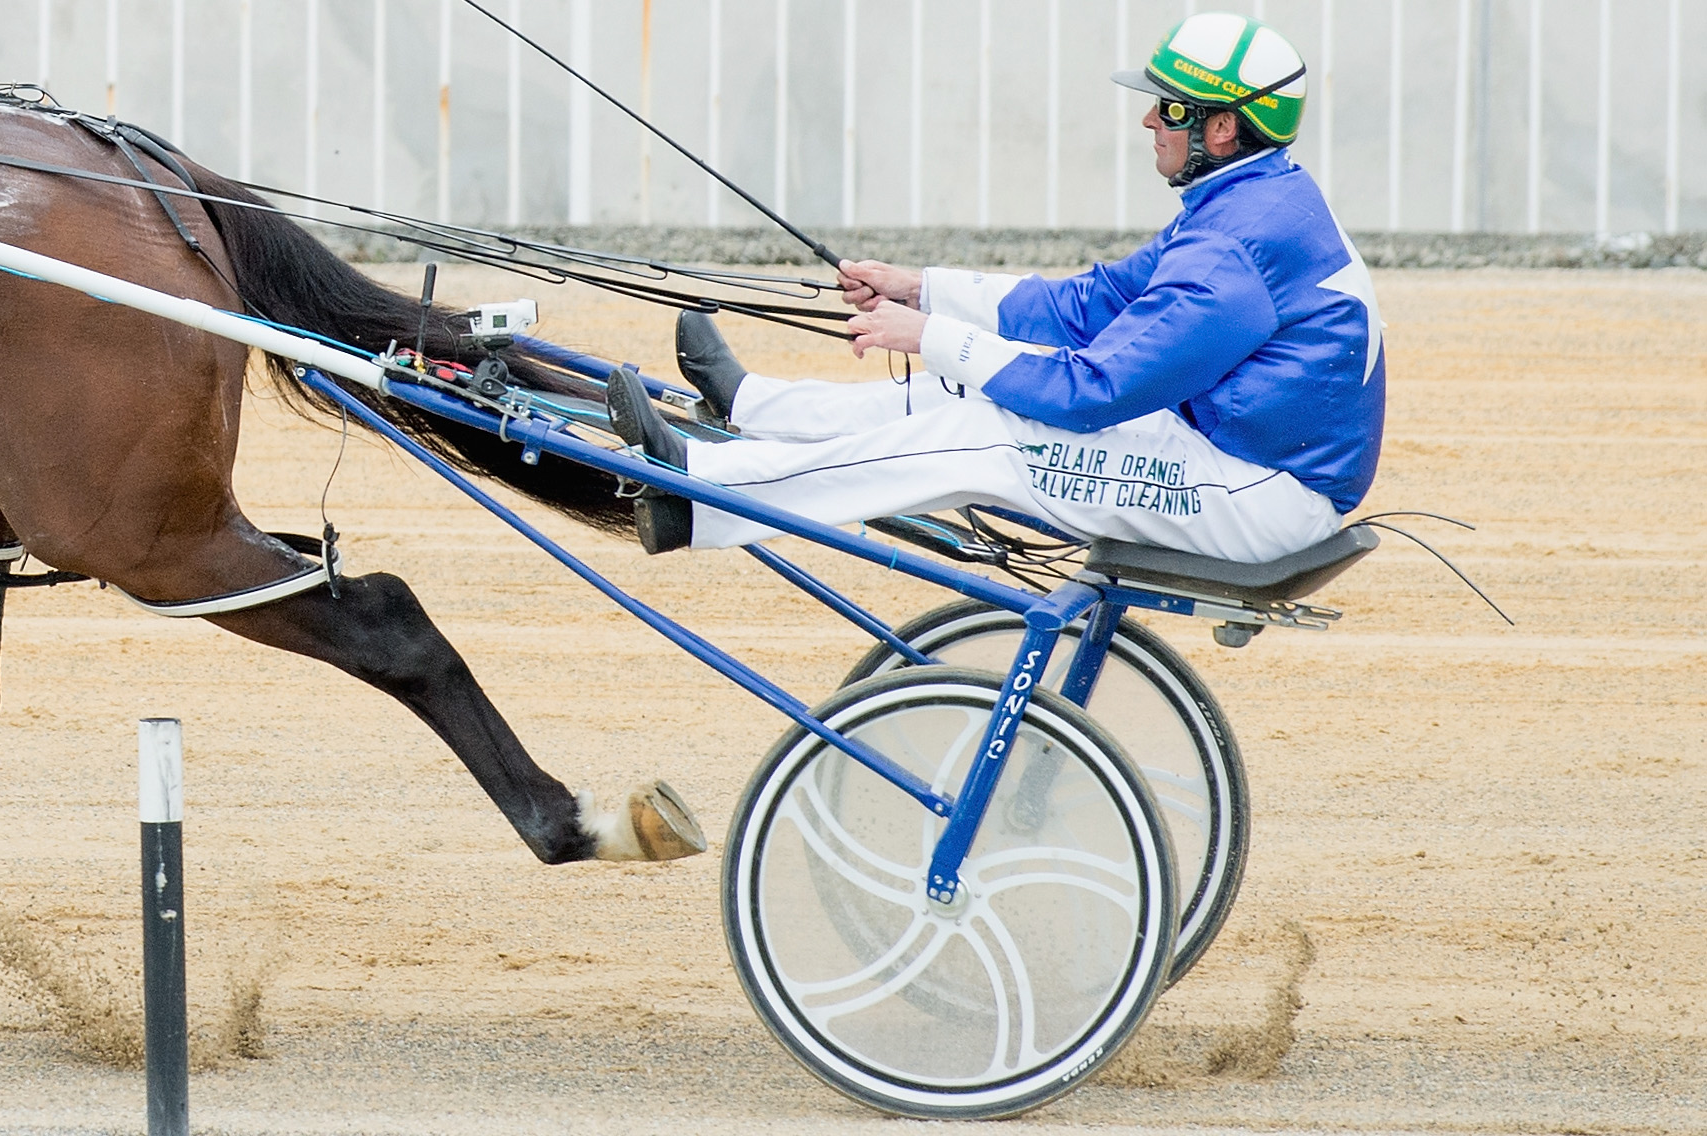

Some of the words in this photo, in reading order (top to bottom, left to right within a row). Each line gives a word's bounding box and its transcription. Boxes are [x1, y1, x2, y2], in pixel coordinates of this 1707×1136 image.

[1173, 58, 1223, 87] CALVERT
[1222, 80, 1279, 110] CLEAING
[1048, 442, 1108, 475] BLAIR
[1115, 482, 1202, 516] CLEANING
[986, 650, 1041, 759] SONIC
[1197, 701, 1224, 746] KENDA
